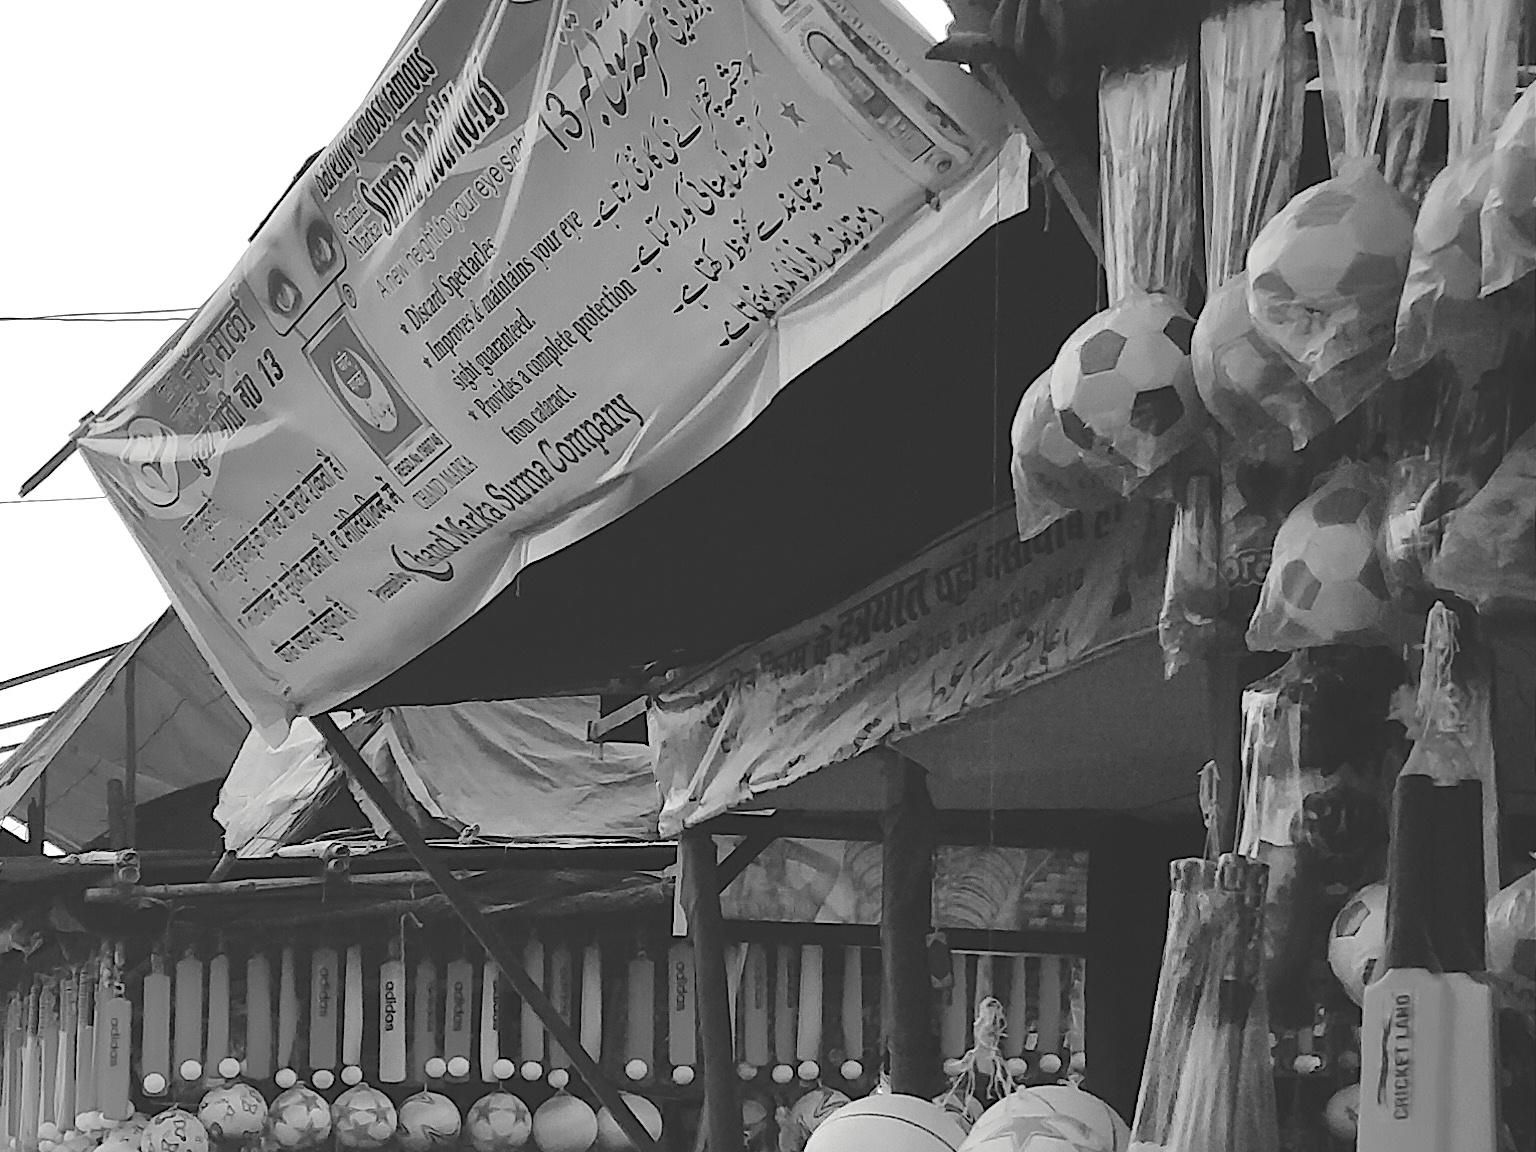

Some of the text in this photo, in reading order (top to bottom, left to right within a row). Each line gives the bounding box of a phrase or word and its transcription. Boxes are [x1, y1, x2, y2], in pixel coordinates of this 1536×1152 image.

[537, 93, 580, 150] 13
[447, 190, 480, 231] your
[472, 163, 504, 198] eye
[404, 235, 497, 331] Discard Spectacles
[425, 209, 584, 362] Improves & maintains your eye
[256, 347, 286, 387] 13
[451, 306, 536, 390] sight guaranteed.
[473, 274, 637, 419] Provides a complete protection
[501, 380, 577, 444] from cataract.
[412, 475, 449, 511] CHAND
[438, 451, 477, 489] MARKA
[437, 502, 506, 545] Marka
[484, 460, 554, 514] Surma
[538, 392, 644, 473] Company
[384, 981, 395, 1033] adidas
[108, 1015, 120, 1068] adidas
[1393, 993, 1412, 1121] CRICKET LAND
